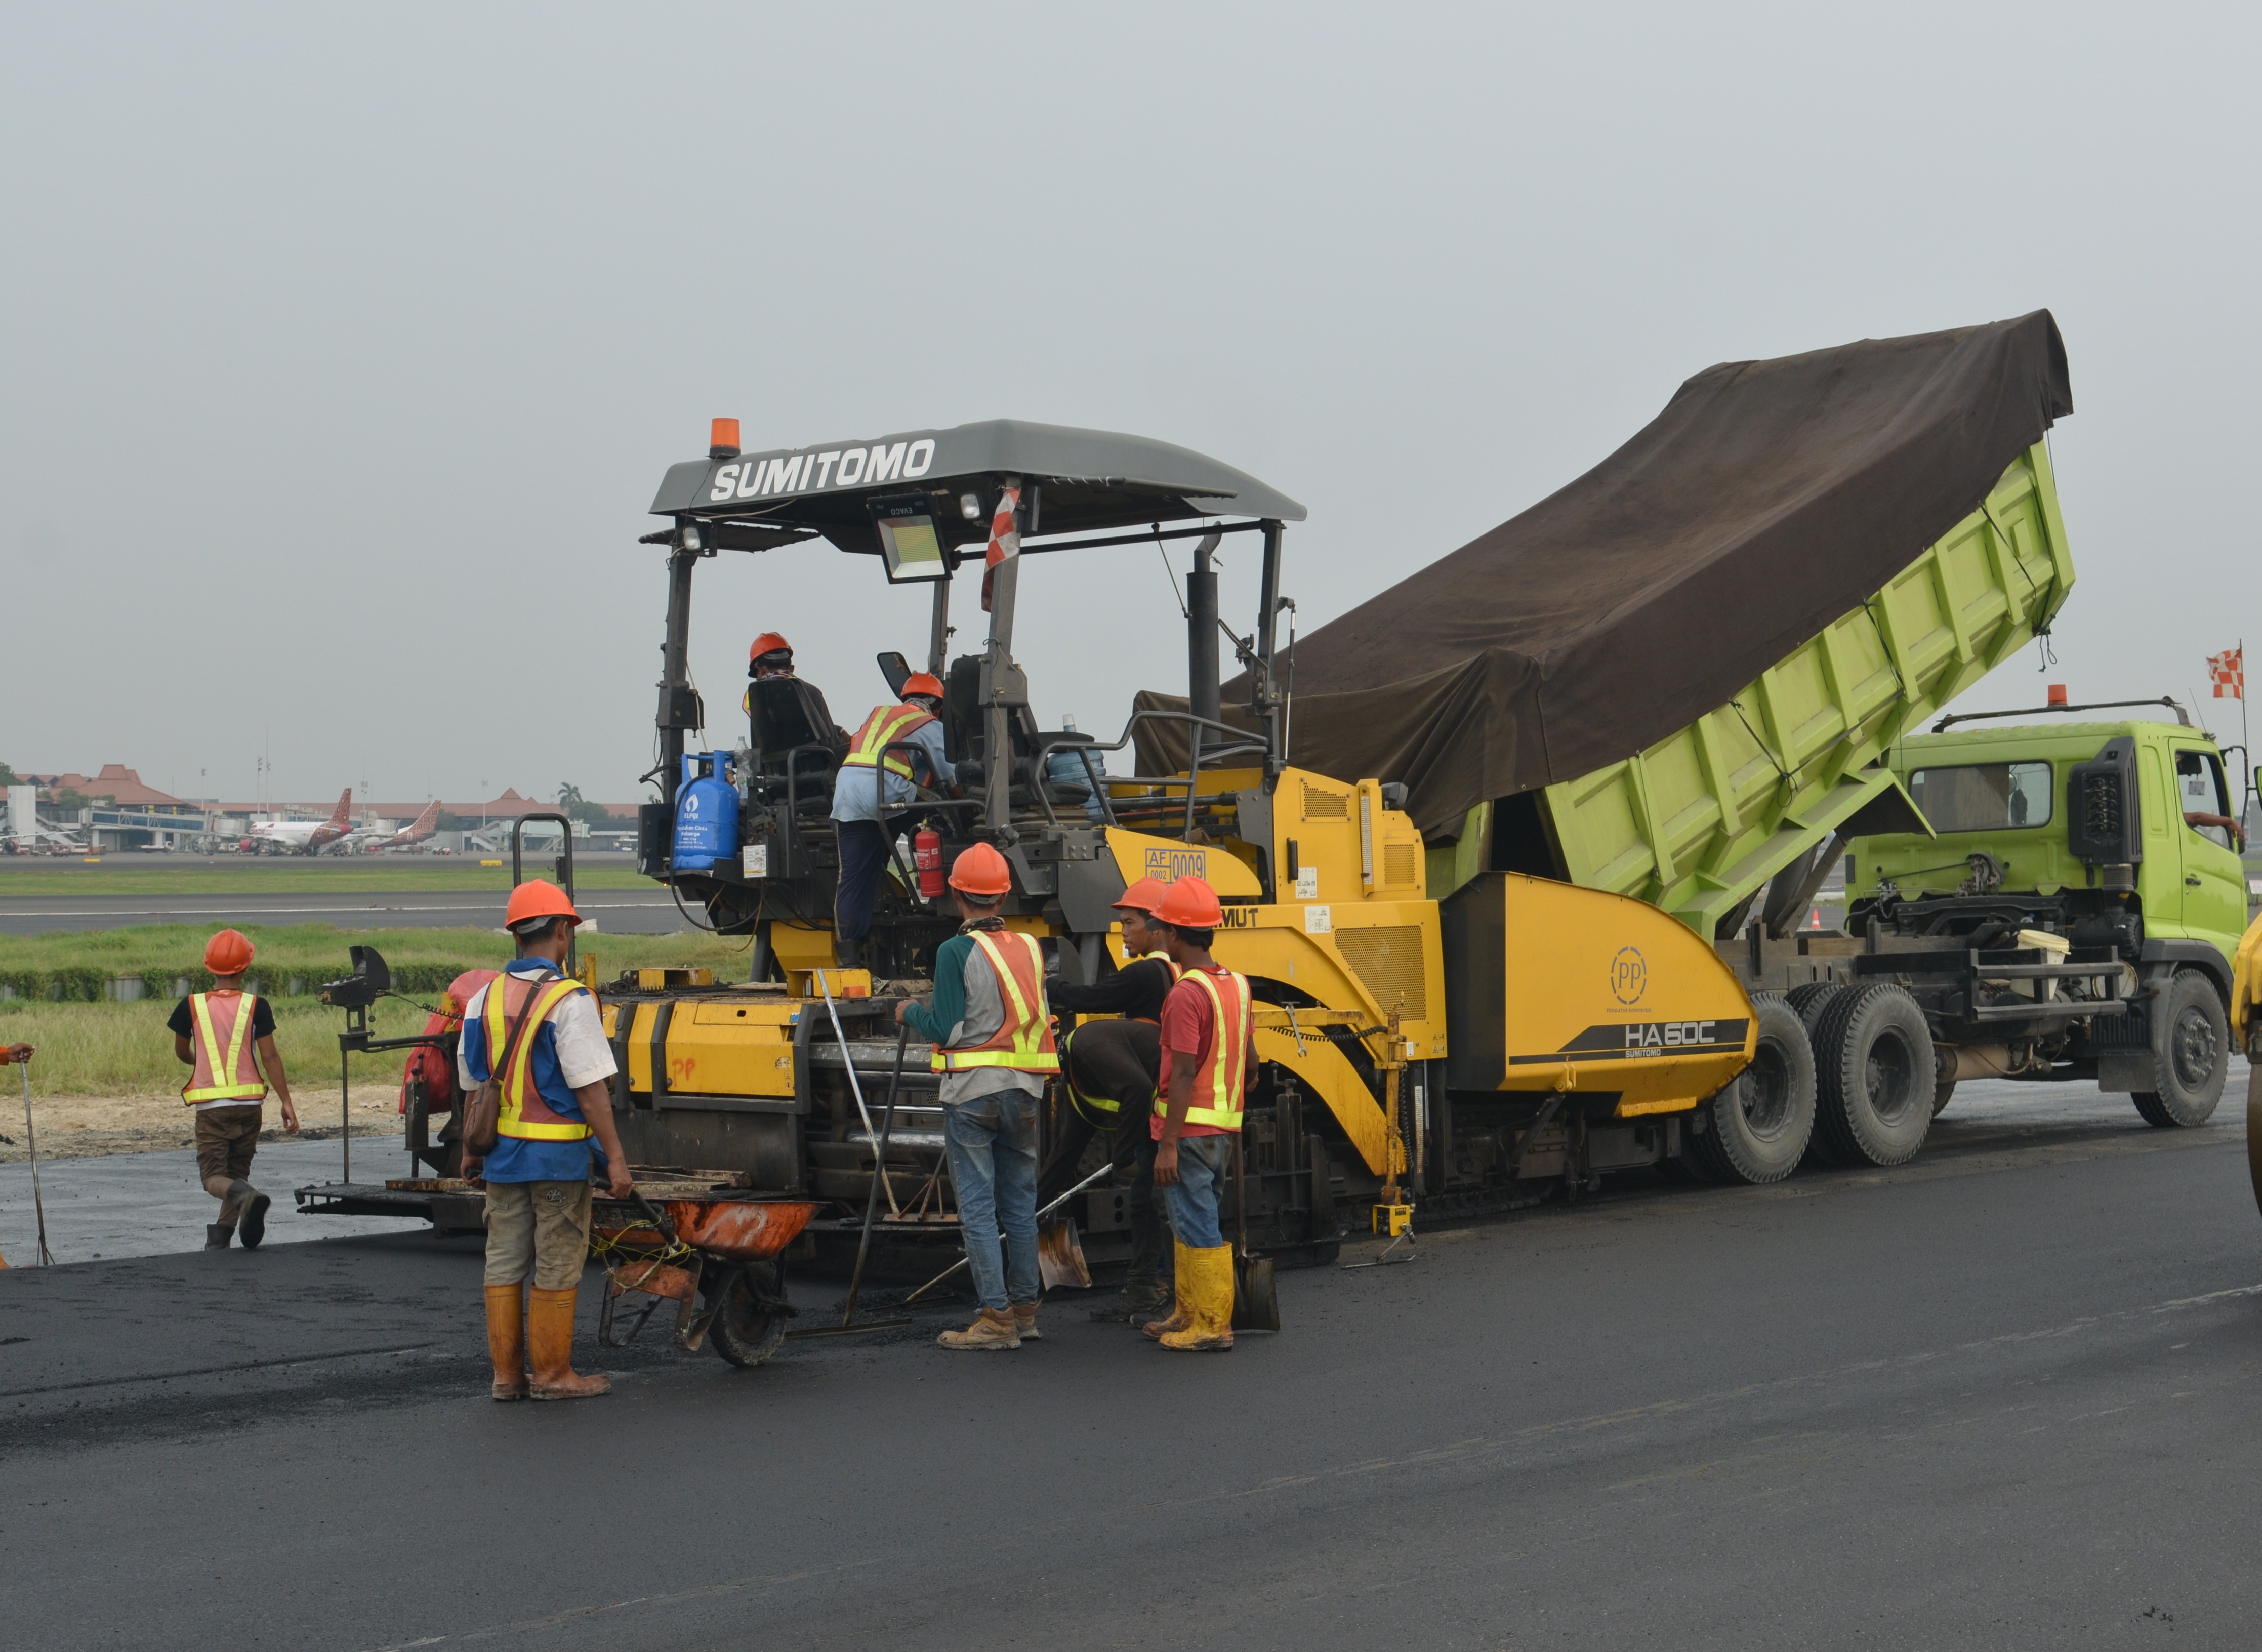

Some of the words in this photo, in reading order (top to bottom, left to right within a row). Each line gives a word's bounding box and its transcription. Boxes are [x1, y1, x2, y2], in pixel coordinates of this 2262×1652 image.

[710, 439, 935, 501] SUMITOMO
[891, 507, 913, 515] EVACO
[1149, 851, 1166, 865] AF
[1173, 854, 1203, 880] 0009
[1150, 870, 1166, 879] 0002
[1618, 962, 1641, 989] PP
[1625, 1049, 1661, 1058] SUMITOMO
